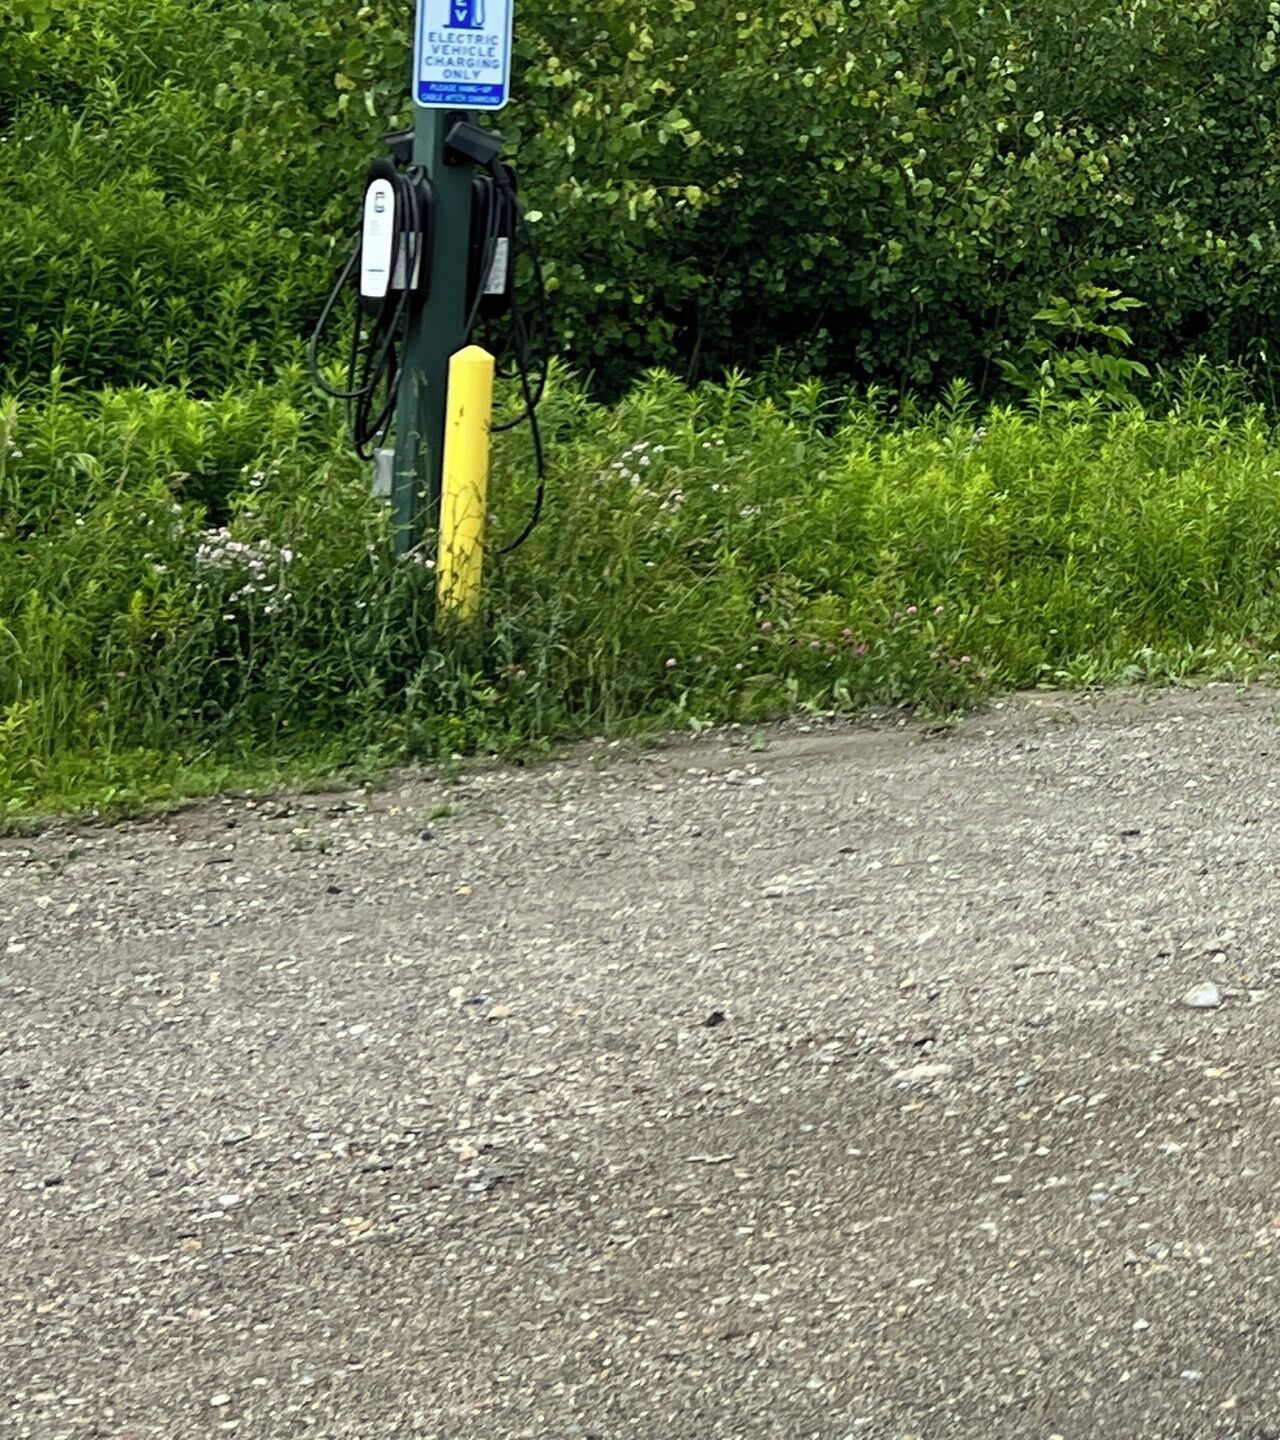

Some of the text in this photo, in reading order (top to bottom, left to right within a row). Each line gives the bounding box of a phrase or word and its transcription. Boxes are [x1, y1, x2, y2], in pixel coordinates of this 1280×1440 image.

[428, 32, 499, 45] ELECTRIC
[431, 44, 496, 58] VEHICLE
[425, 55, 500, 69] CHARGING
[442, 68, 482, 80] ONLY
